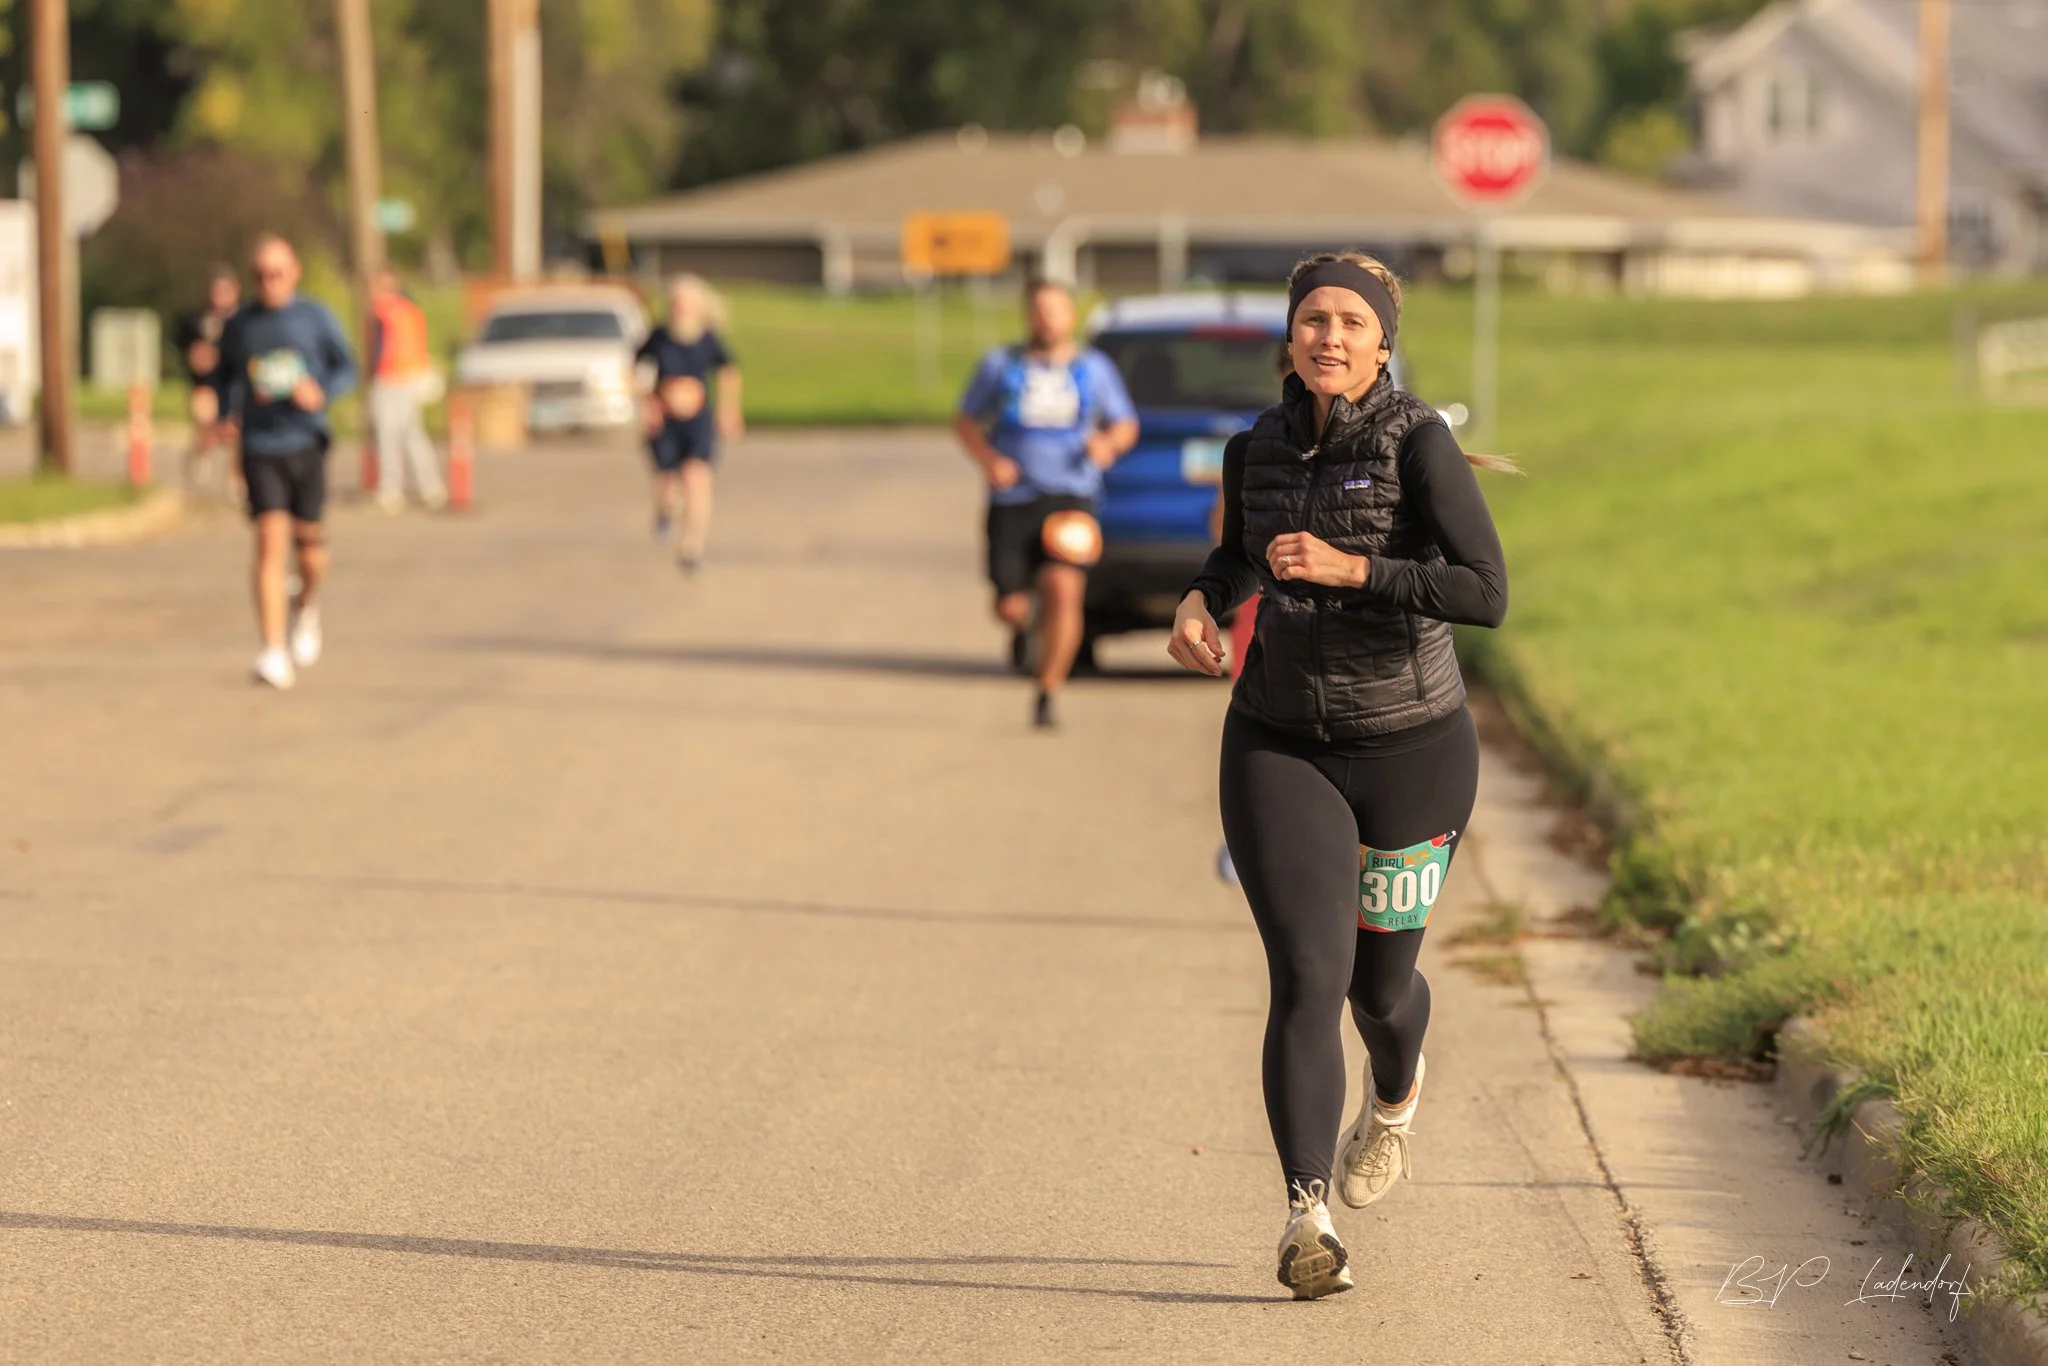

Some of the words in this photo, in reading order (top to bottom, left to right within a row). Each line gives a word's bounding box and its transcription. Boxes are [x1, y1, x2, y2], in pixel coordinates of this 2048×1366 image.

[1439, 124, 1541, 178] STOP
[1361, 861, 1441, 914] 300
[1388, 914, 1418, 926] RELAY
